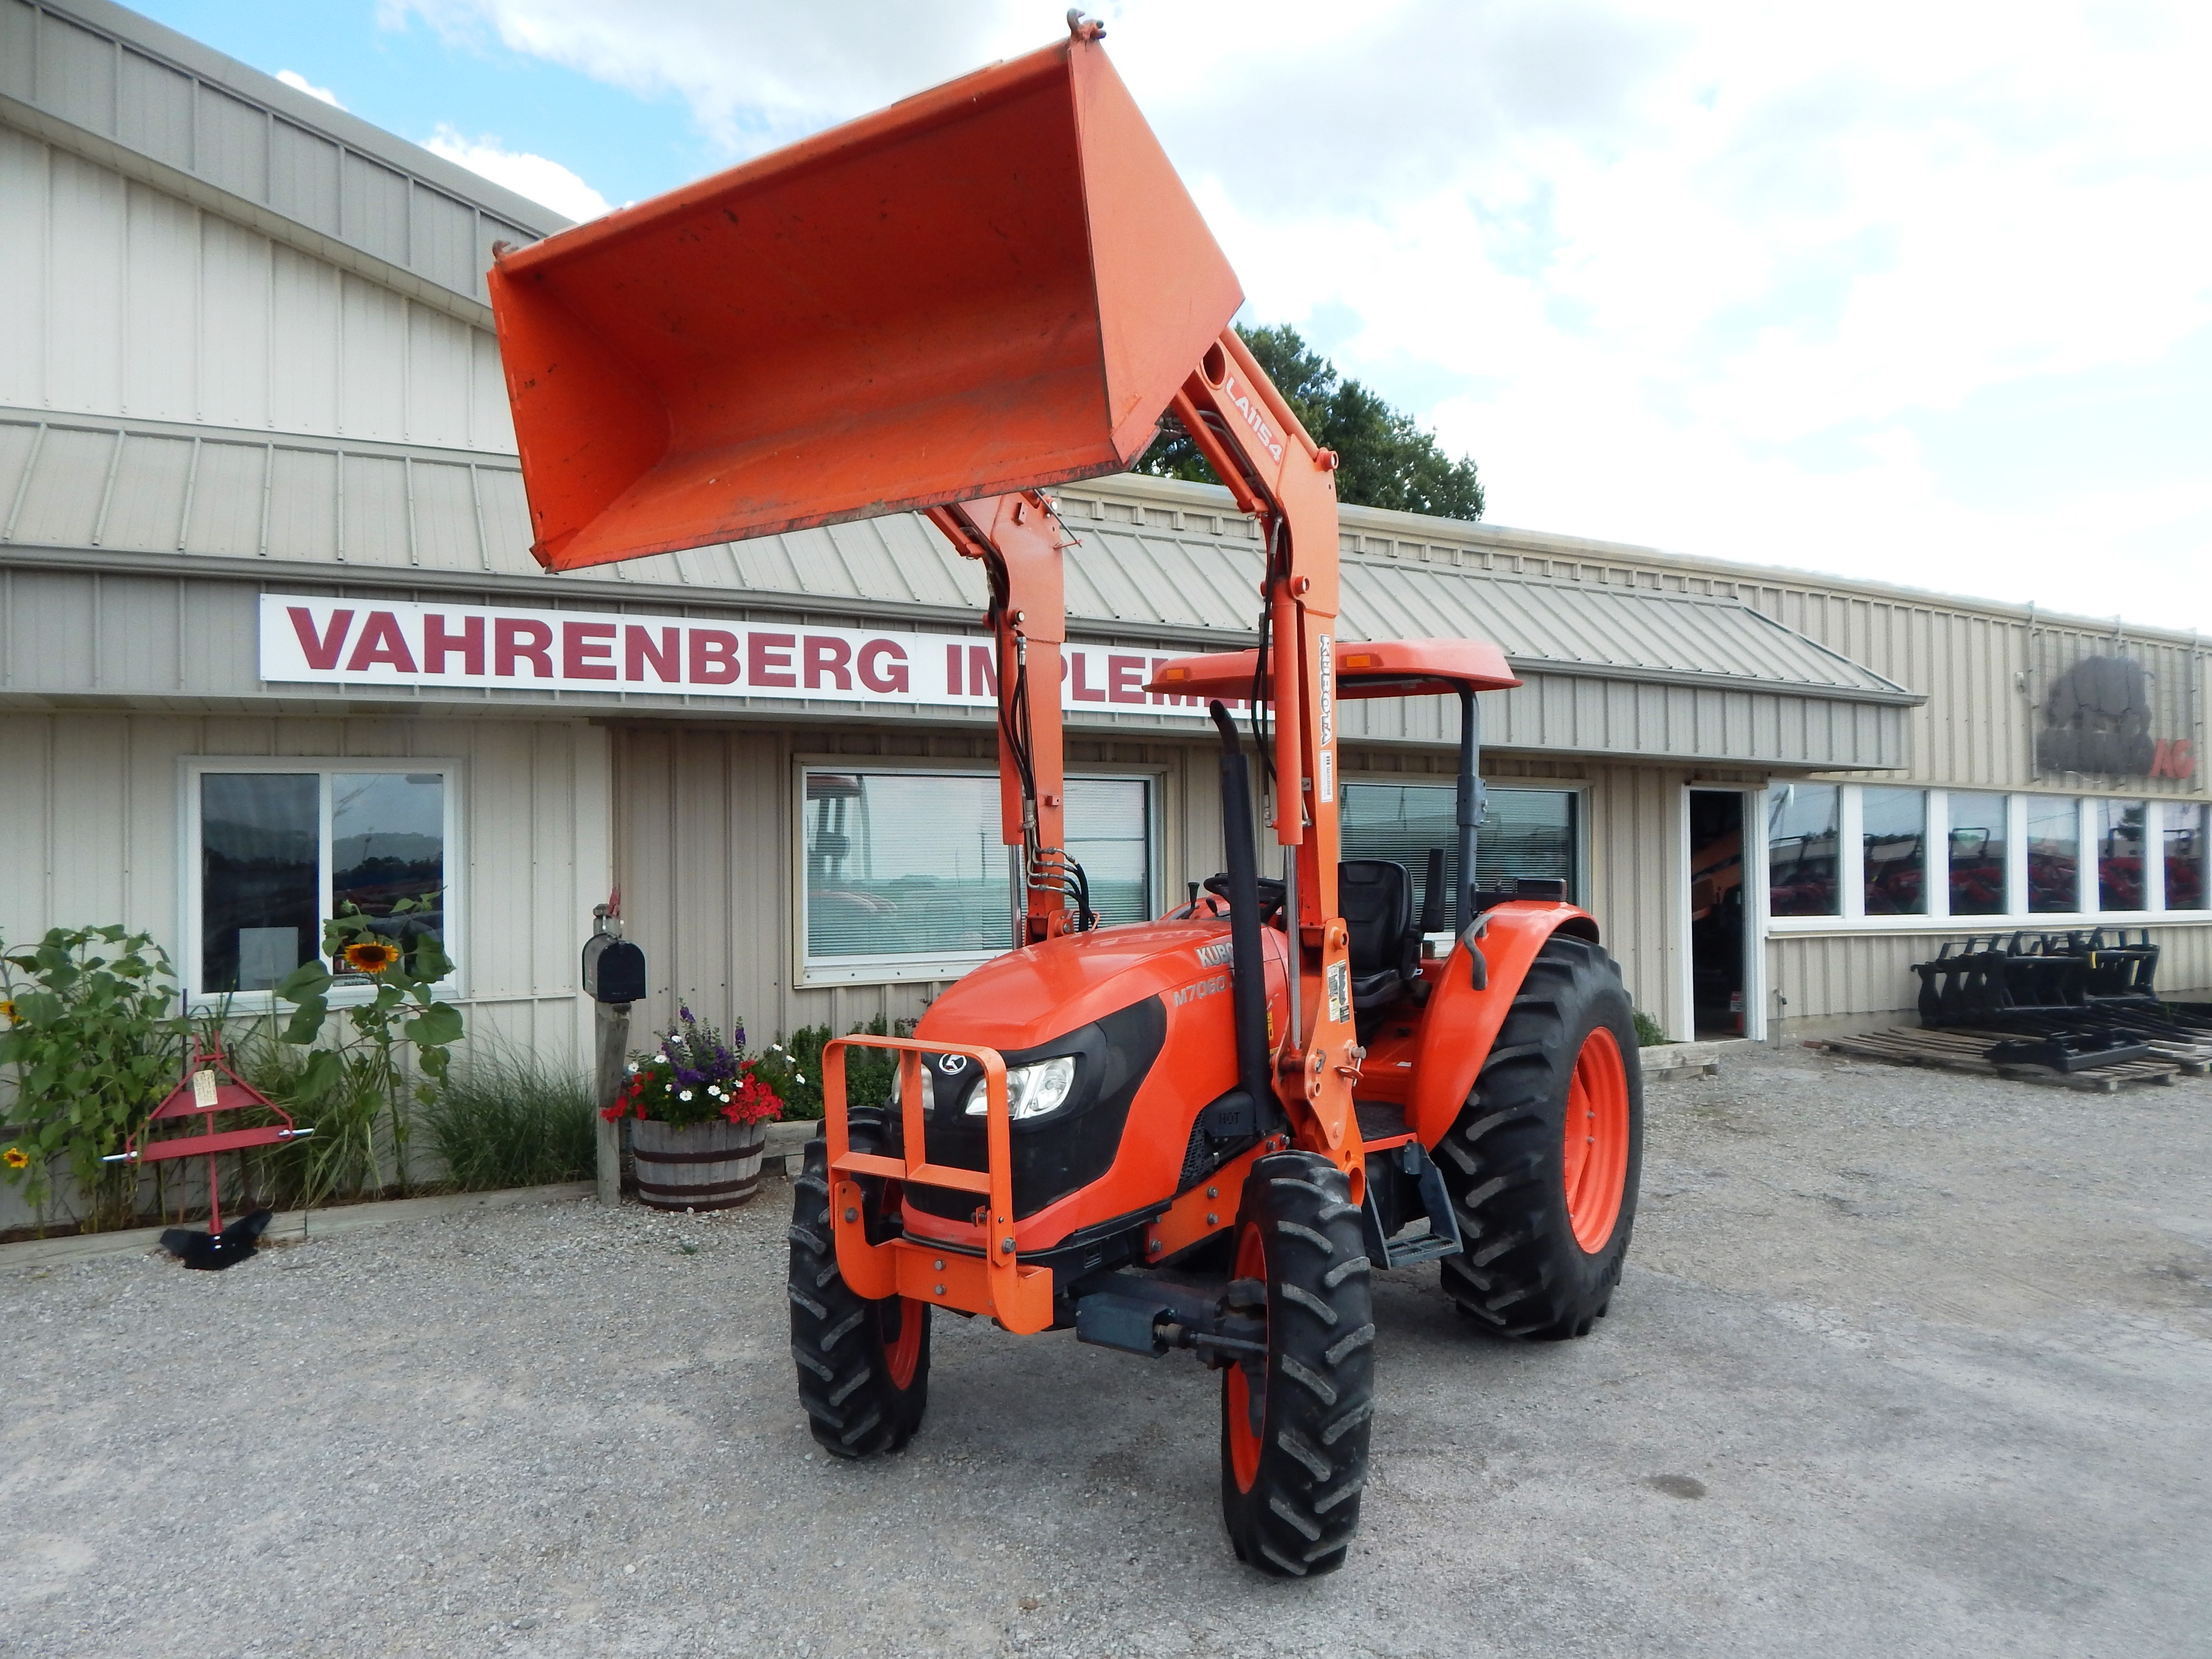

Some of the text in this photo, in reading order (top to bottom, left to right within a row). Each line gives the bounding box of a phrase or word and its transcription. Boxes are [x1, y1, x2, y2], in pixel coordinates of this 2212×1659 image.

[1226, 377, 1283, 461] LA1154
[286, 606, 909, 694] VAHRENBERG
[1320, 635, 1332, 747] KUBOTA
[1173, 975, 1226, 1007] M7060
[1219, 1111, 1240, 1124] HOT
